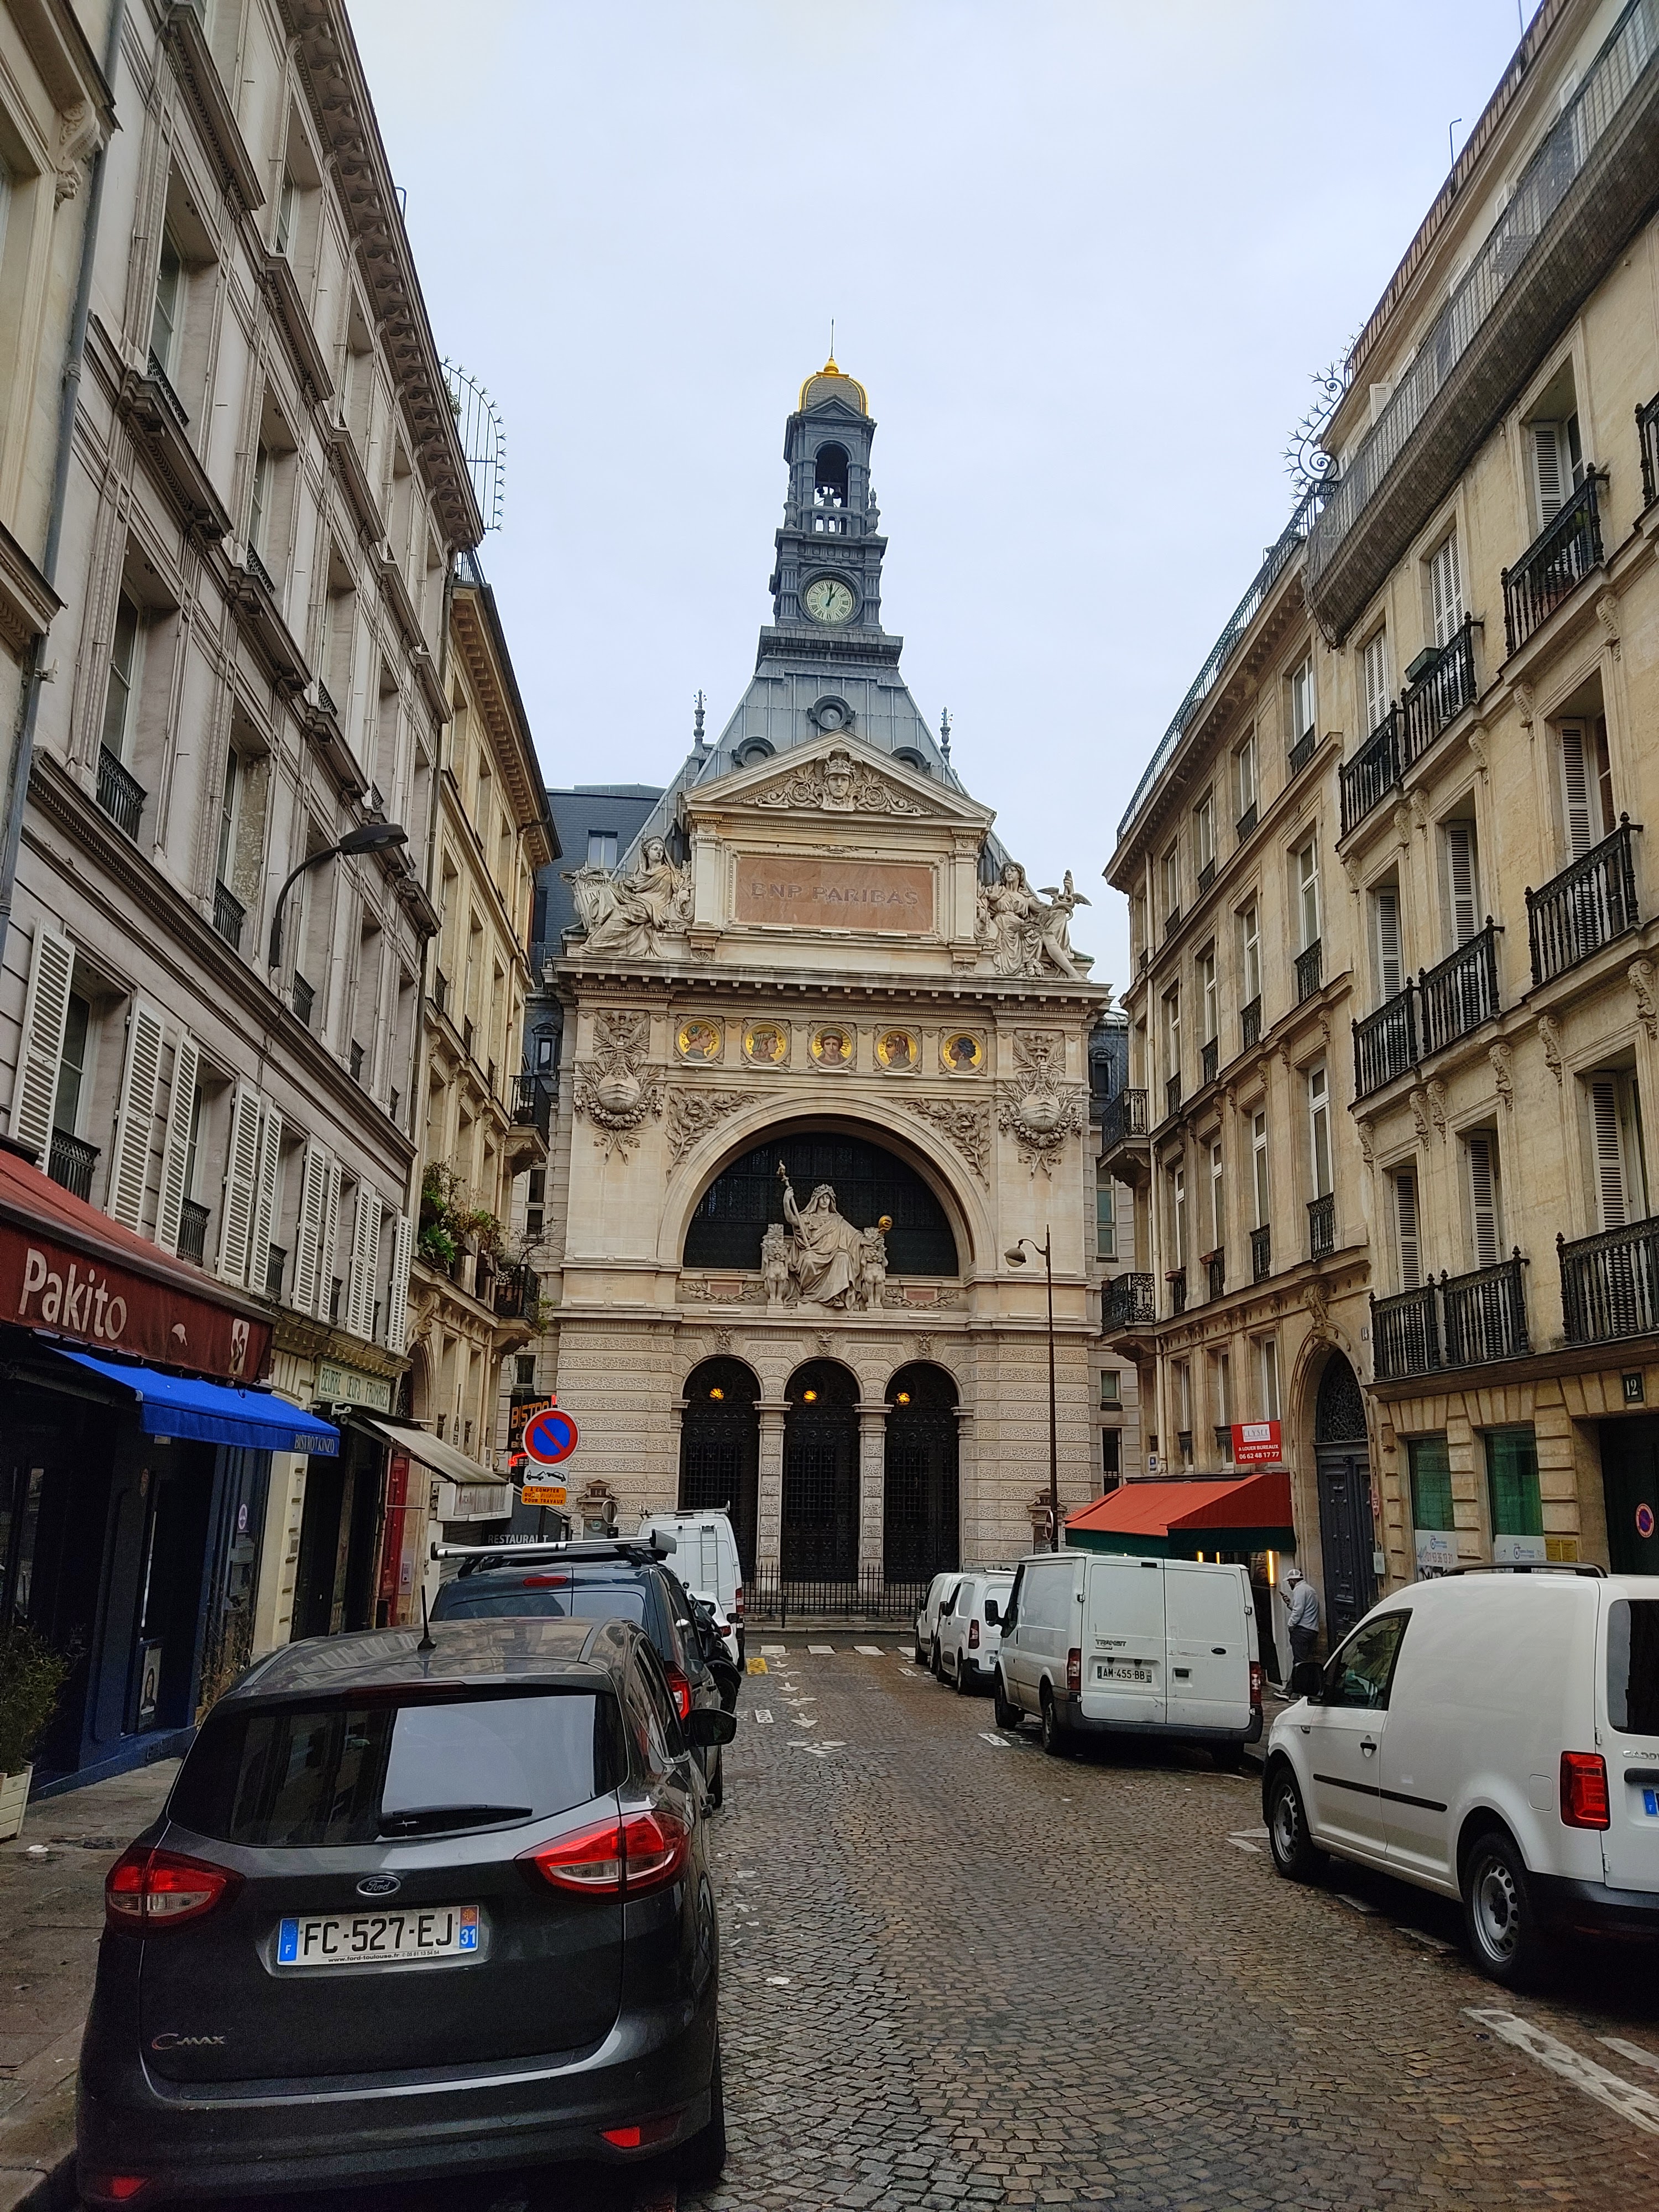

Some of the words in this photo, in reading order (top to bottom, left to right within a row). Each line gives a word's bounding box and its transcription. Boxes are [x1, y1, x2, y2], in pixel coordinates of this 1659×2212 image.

[751, 883, 802, 898] BNP
[812, 886, 918, 905] PARIBAS
[18, 1248, 127, 1340] Pakito
[321, 1367, 342, 1395] BEURRE
[365, 1381, 388, 1407] FROMAGES
[1626, 1379, 1638, 1396] 12
[317, 1437, 335, 1454] KINZO
[1095, 1639, 1127, 1647] TRANSIT
[1103, 1667, 1145, 1680] AM-455-BB
[366, 1880, 391, 1892] Ford
[285, 1944, 292, 1954] F
[303, 1913, 453, 1956] FC-527-EJ
[461, 1928, 476, 1945] 31
[327, 1953, 400, 1963] www.ford-toulouse.fr
